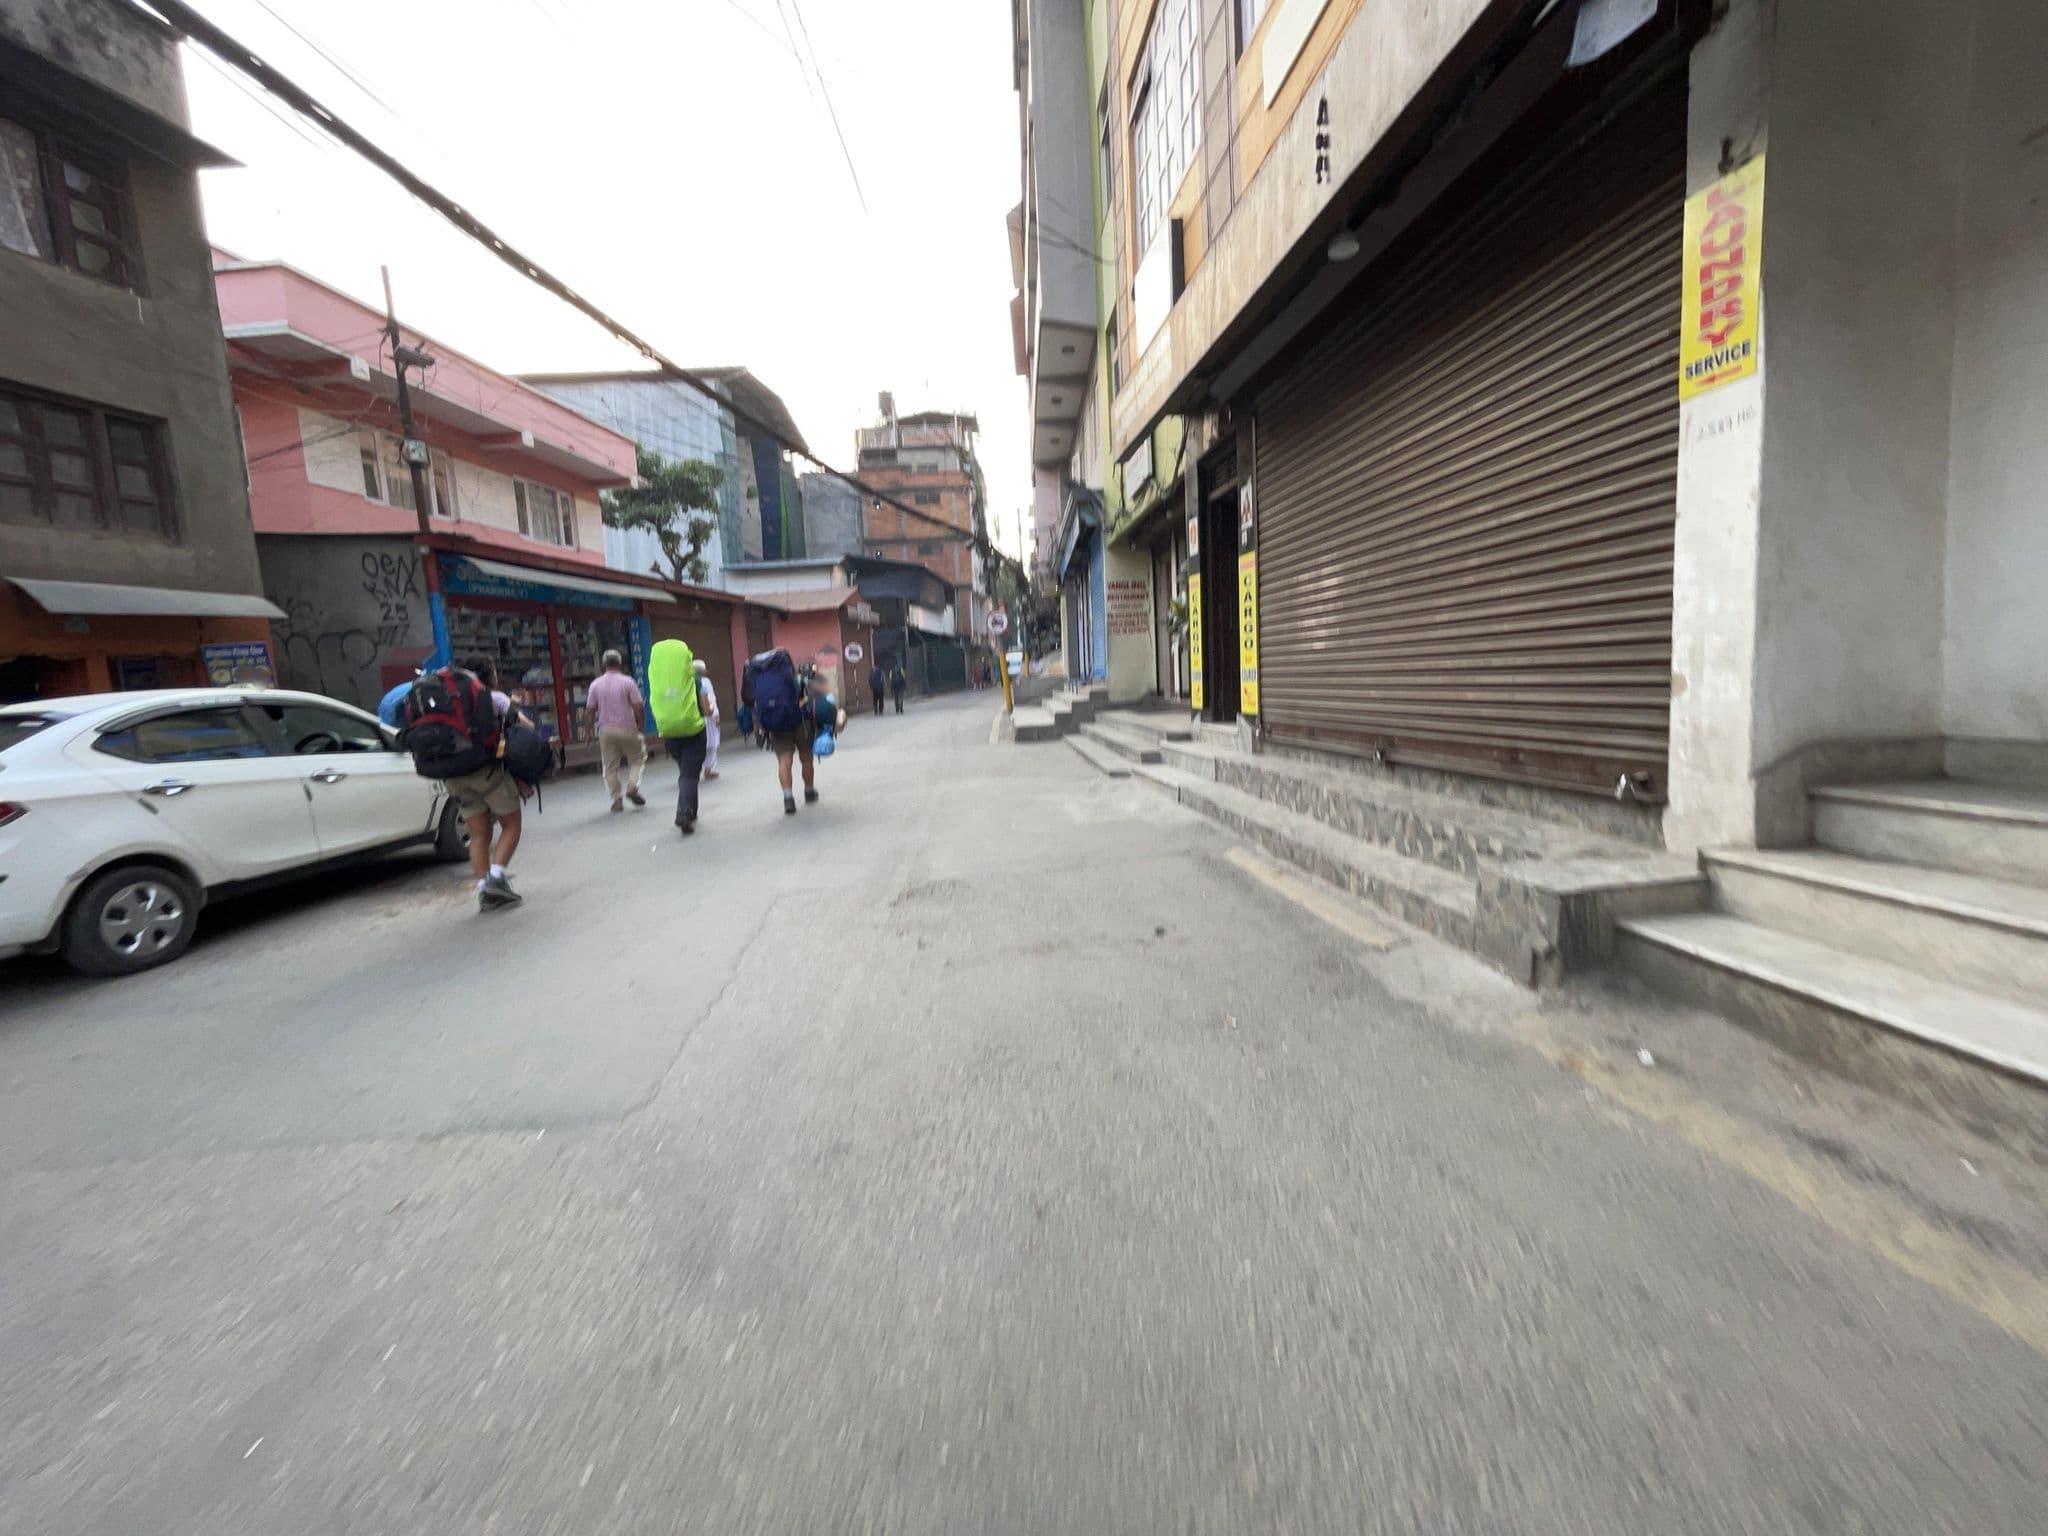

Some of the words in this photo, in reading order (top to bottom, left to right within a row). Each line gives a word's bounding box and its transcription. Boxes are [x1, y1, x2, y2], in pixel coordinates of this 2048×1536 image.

[1685, 340, 1751, 381] SERVICE
[1192, 592, 1200, 655] CARGO
[1243, 574, 1254, 650] CARGO
